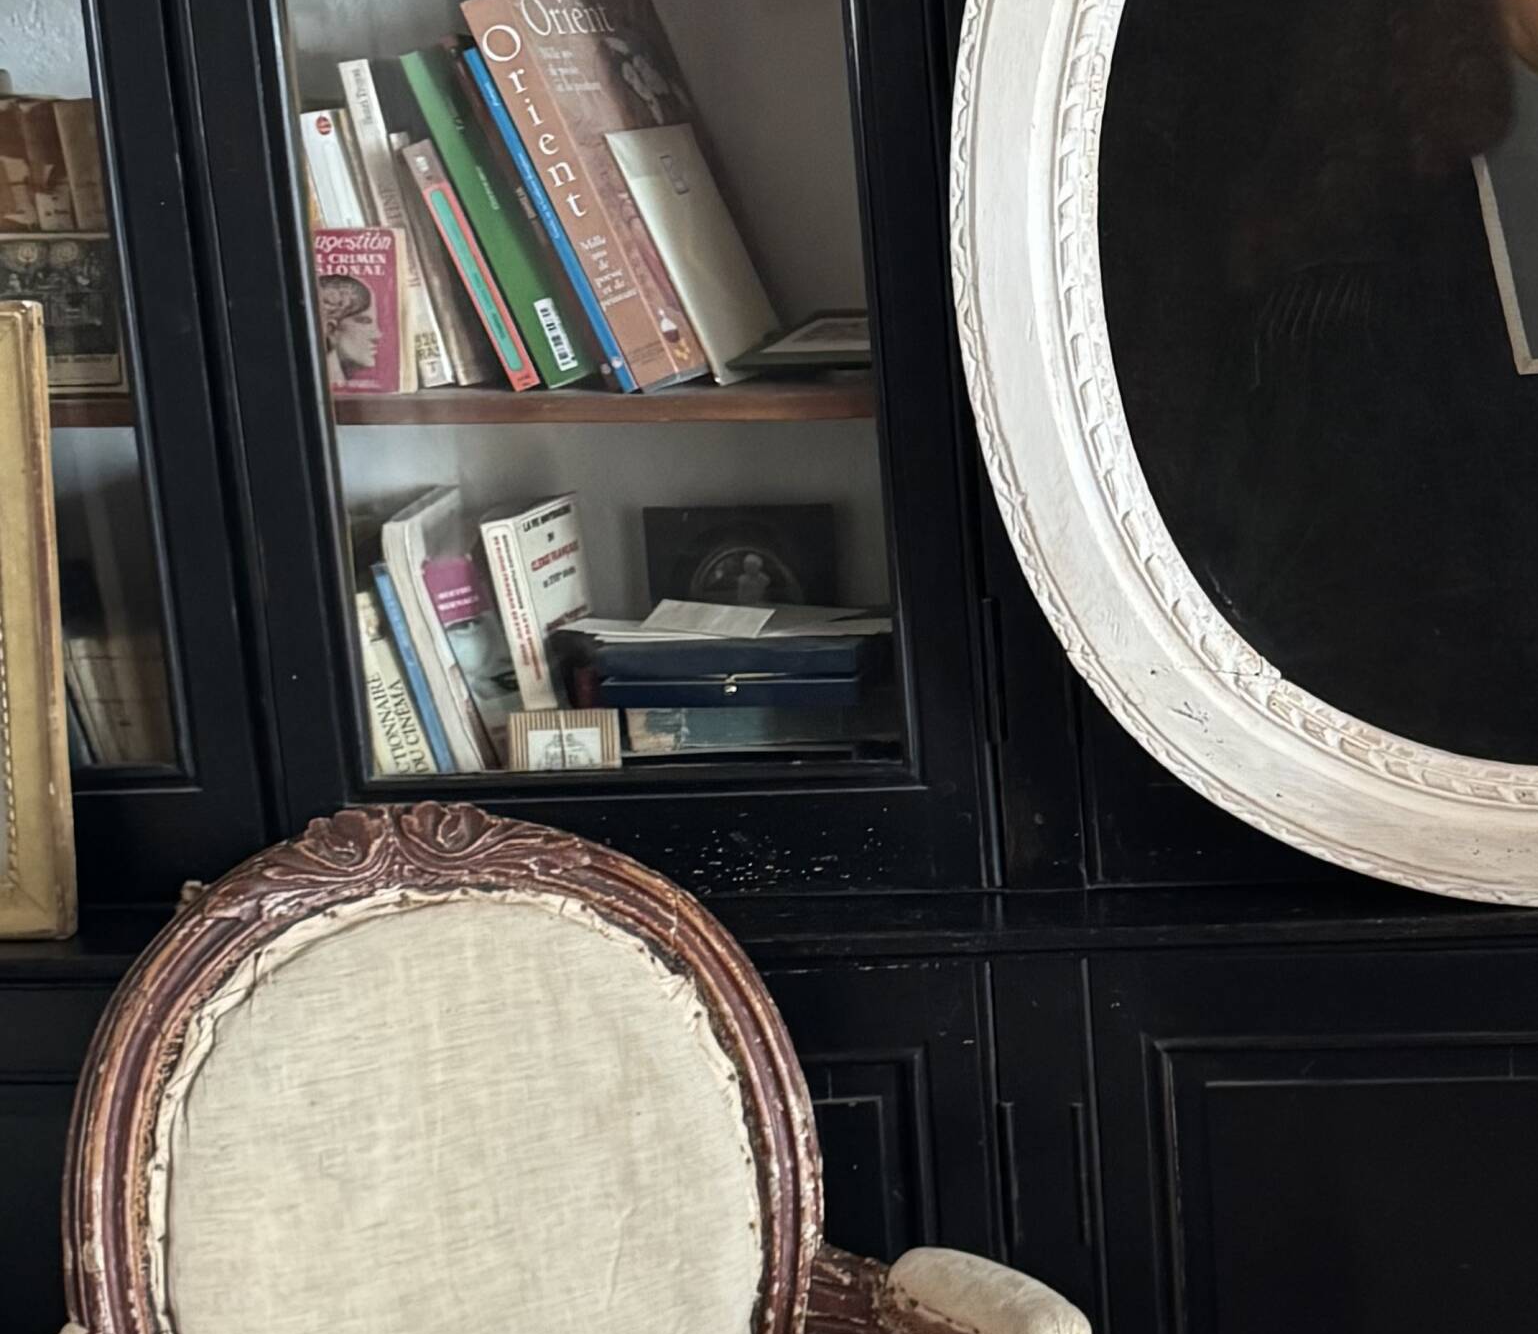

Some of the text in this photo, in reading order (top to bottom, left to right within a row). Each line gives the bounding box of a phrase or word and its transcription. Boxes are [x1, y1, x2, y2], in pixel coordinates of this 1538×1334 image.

[358, 98, 373, 125] Henri
[481, 24, 587, 217] Orient
[579, 234, 607, 251] Mille
[328, 252, 387, 265] CRIMEN
[409, 747, 431, 773] DU
